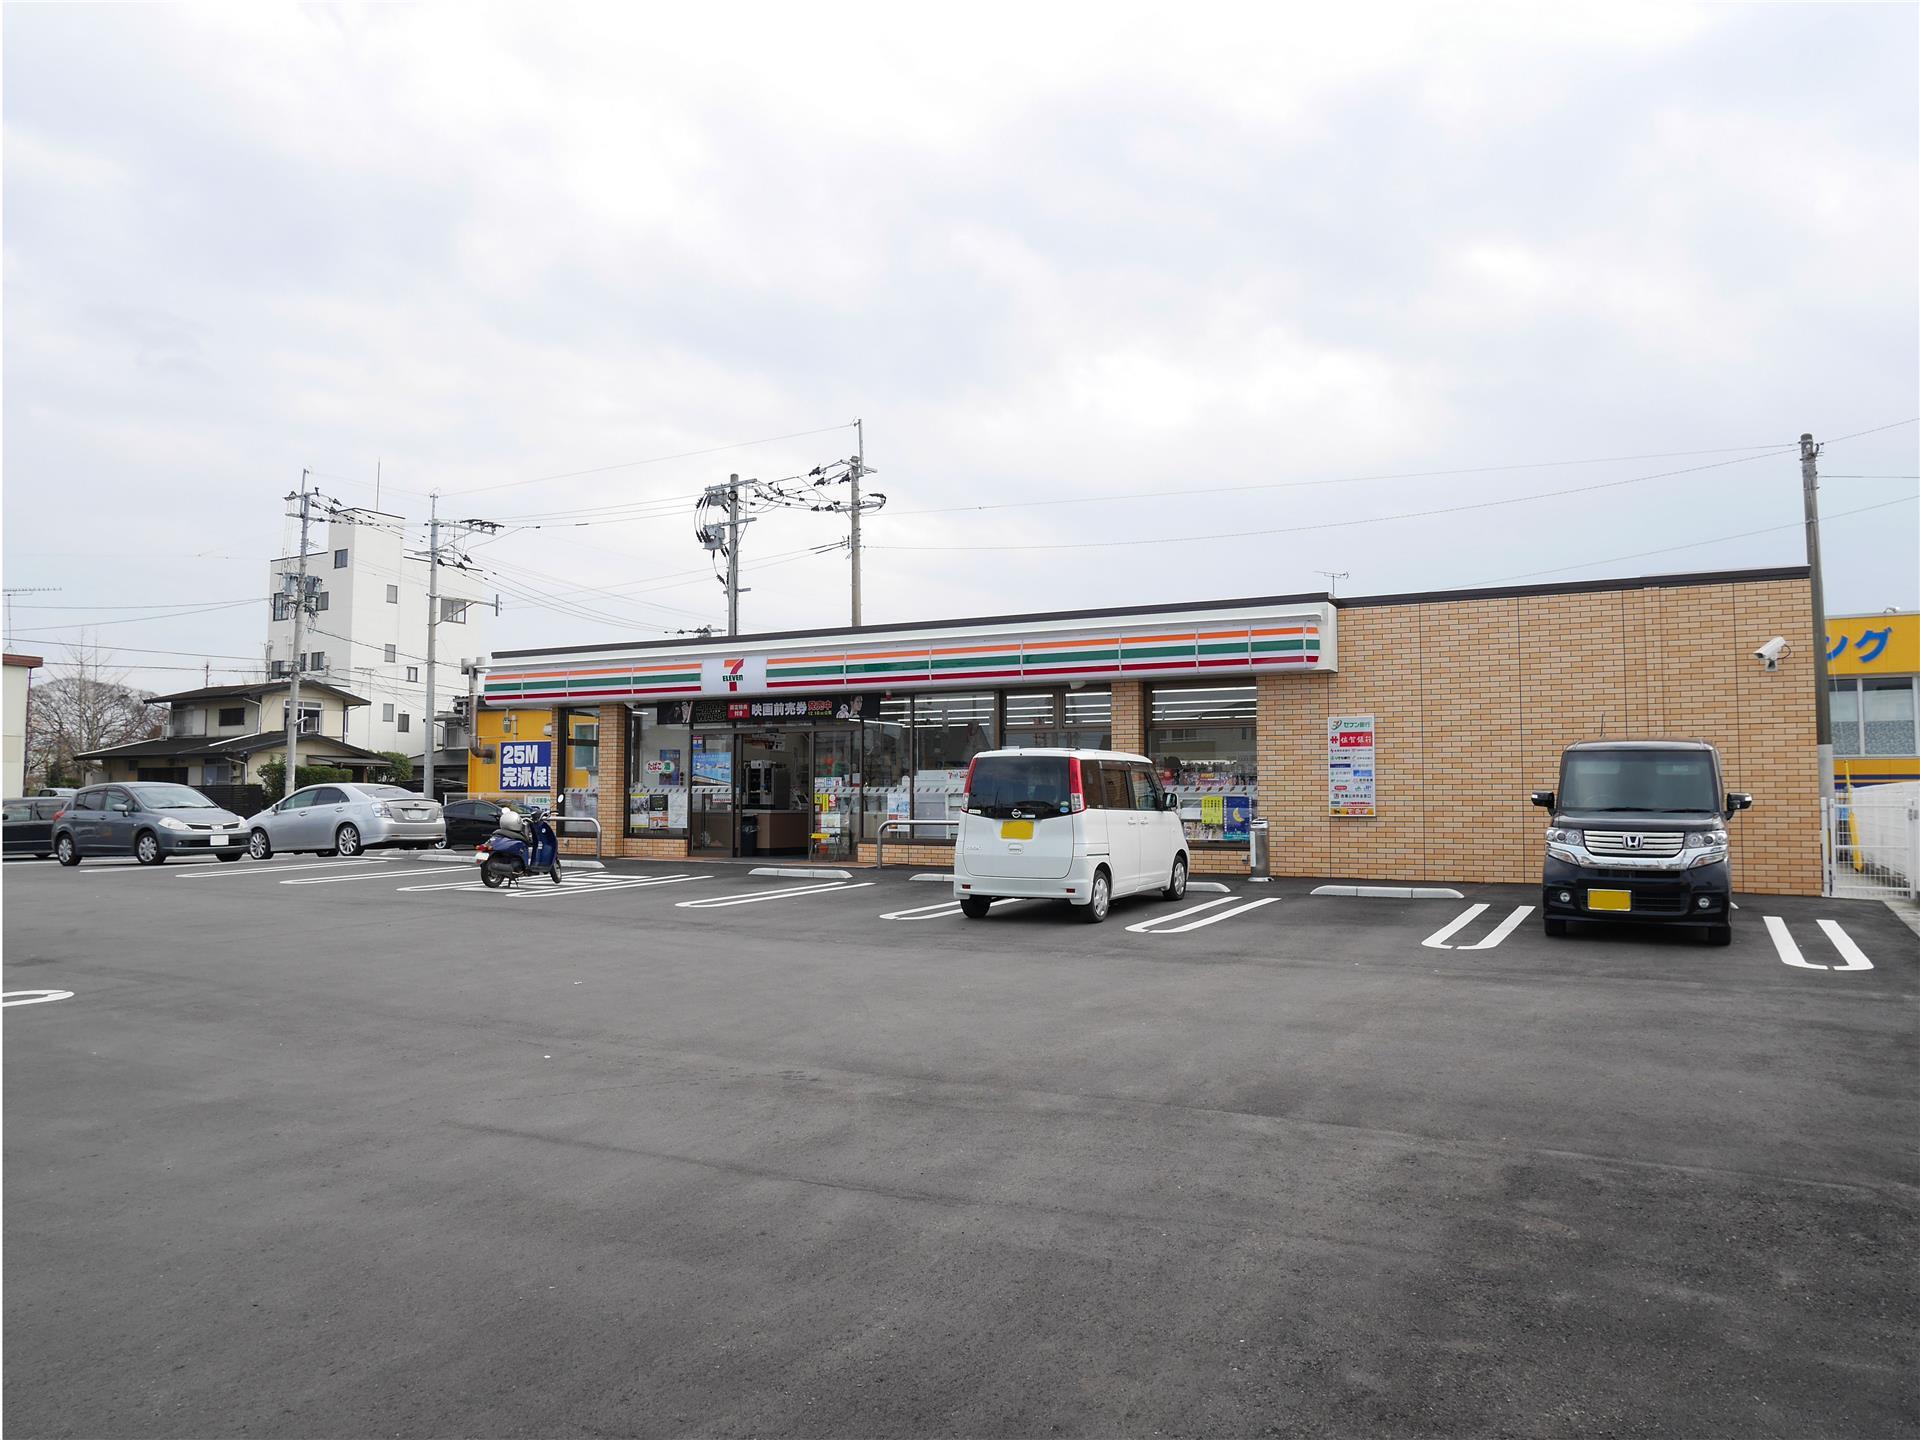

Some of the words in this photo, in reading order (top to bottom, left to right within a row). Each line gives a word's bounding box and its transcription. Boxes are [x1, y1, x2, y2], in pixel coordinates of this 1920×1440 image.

[751, 702, 807, 716] 映画前売券
[502, 745, 538, 764] 25M
[502, 766, 551, 787] 完泳保
